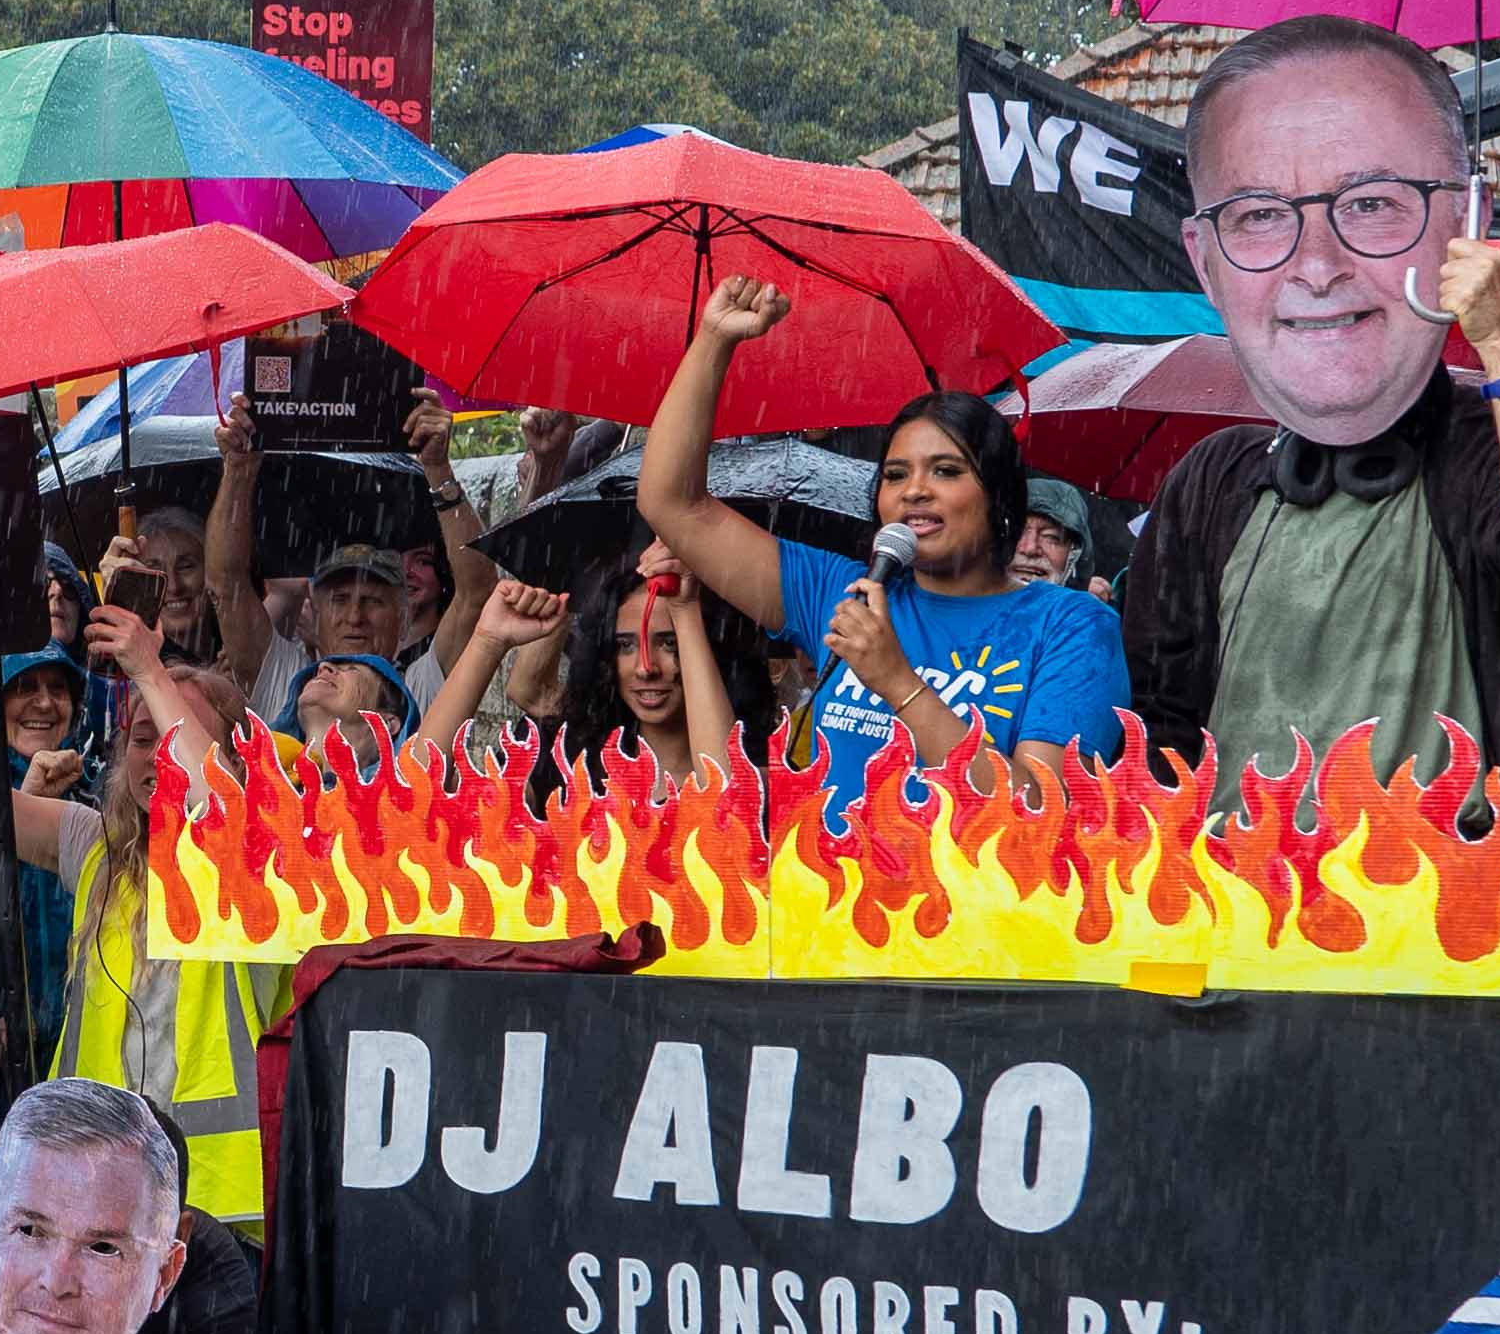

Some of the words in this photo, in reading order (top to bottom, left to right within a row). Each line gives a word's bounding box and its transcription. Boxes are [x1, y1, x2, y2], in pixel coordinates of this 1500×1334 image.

[263, 4, 353, 44] Stop
[265, 47, 395, 88] eling
[966, 92, 1141, 216] WE
[254, 401, 296, 416] TAKE
[300, 402, 356, 417] ACTION
[844, 704, 889, 724] FIGHTING
[858, 723, 894, 740] JUSTI
[341, 1030, 547, 1194] DJ
[612, 1041, 1092, 1234] ALBO
